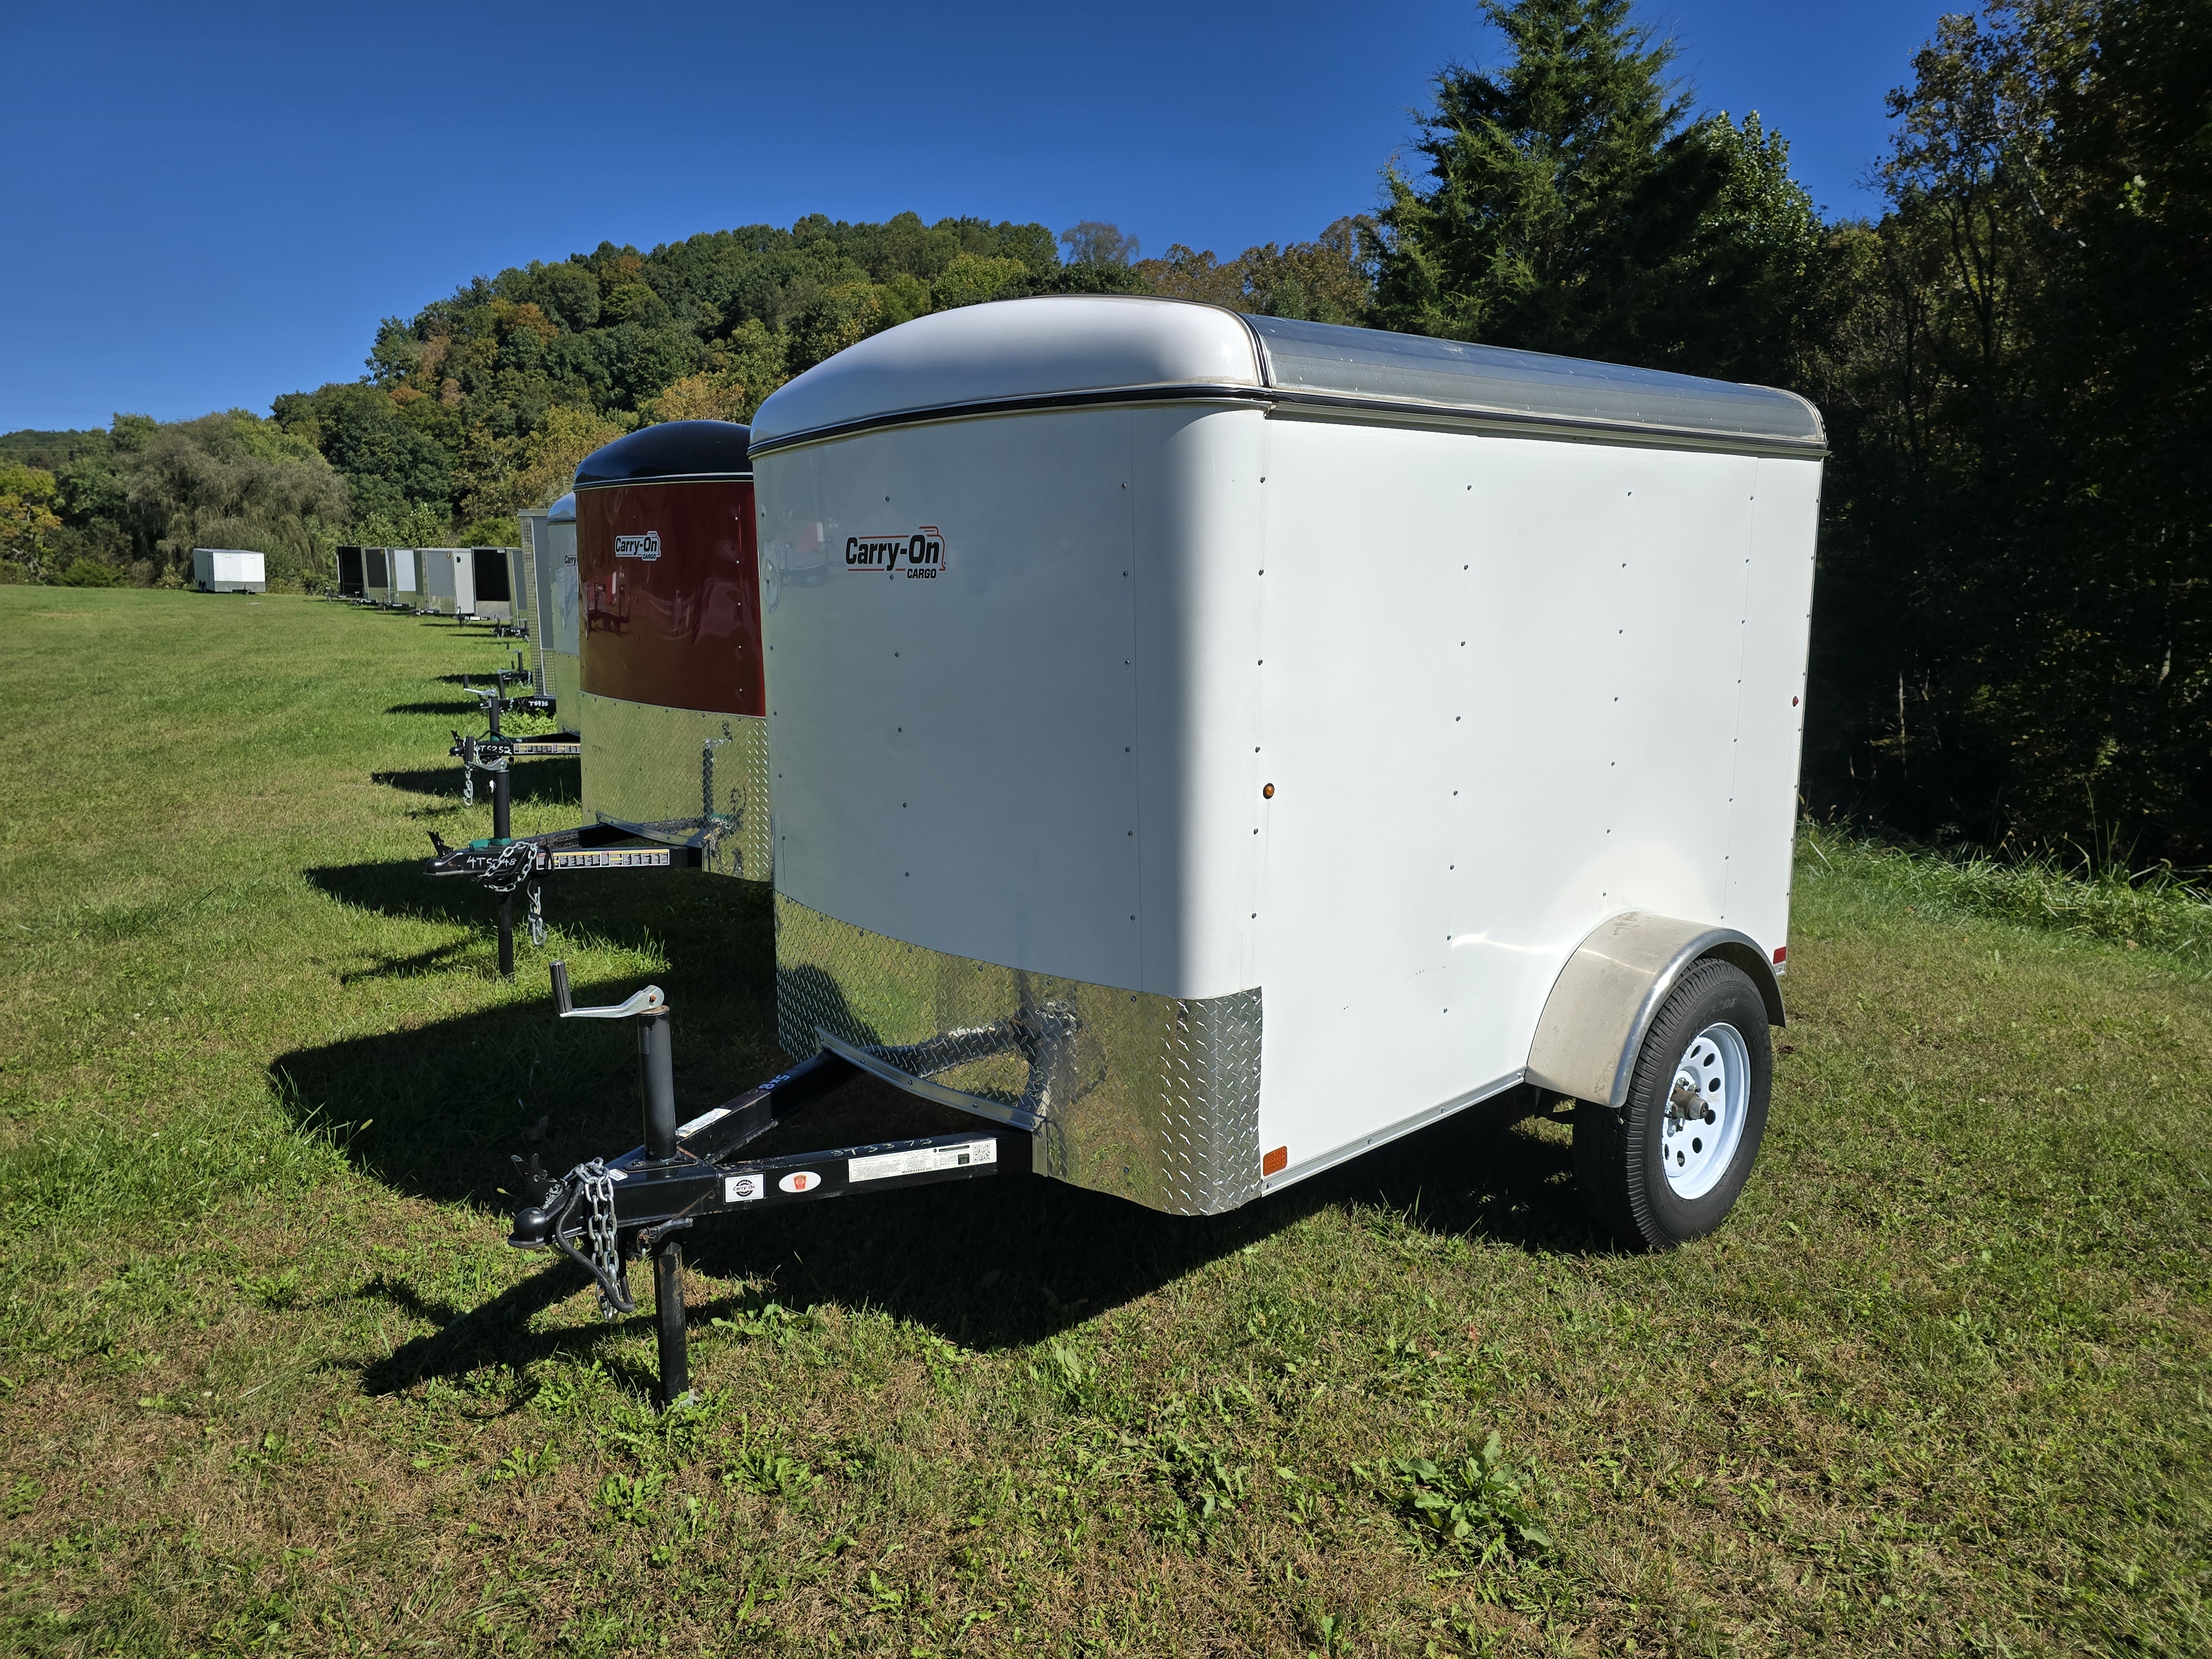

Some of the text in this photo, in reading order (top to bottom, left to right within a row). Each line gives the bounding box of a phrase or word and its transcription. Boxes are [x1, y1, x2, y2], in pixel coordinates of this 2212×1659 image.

[615, 536, 658, 555] Carry-On
[846, 534, 940, 571] Carry-On
[907, 568, 937, 578] CARGO
